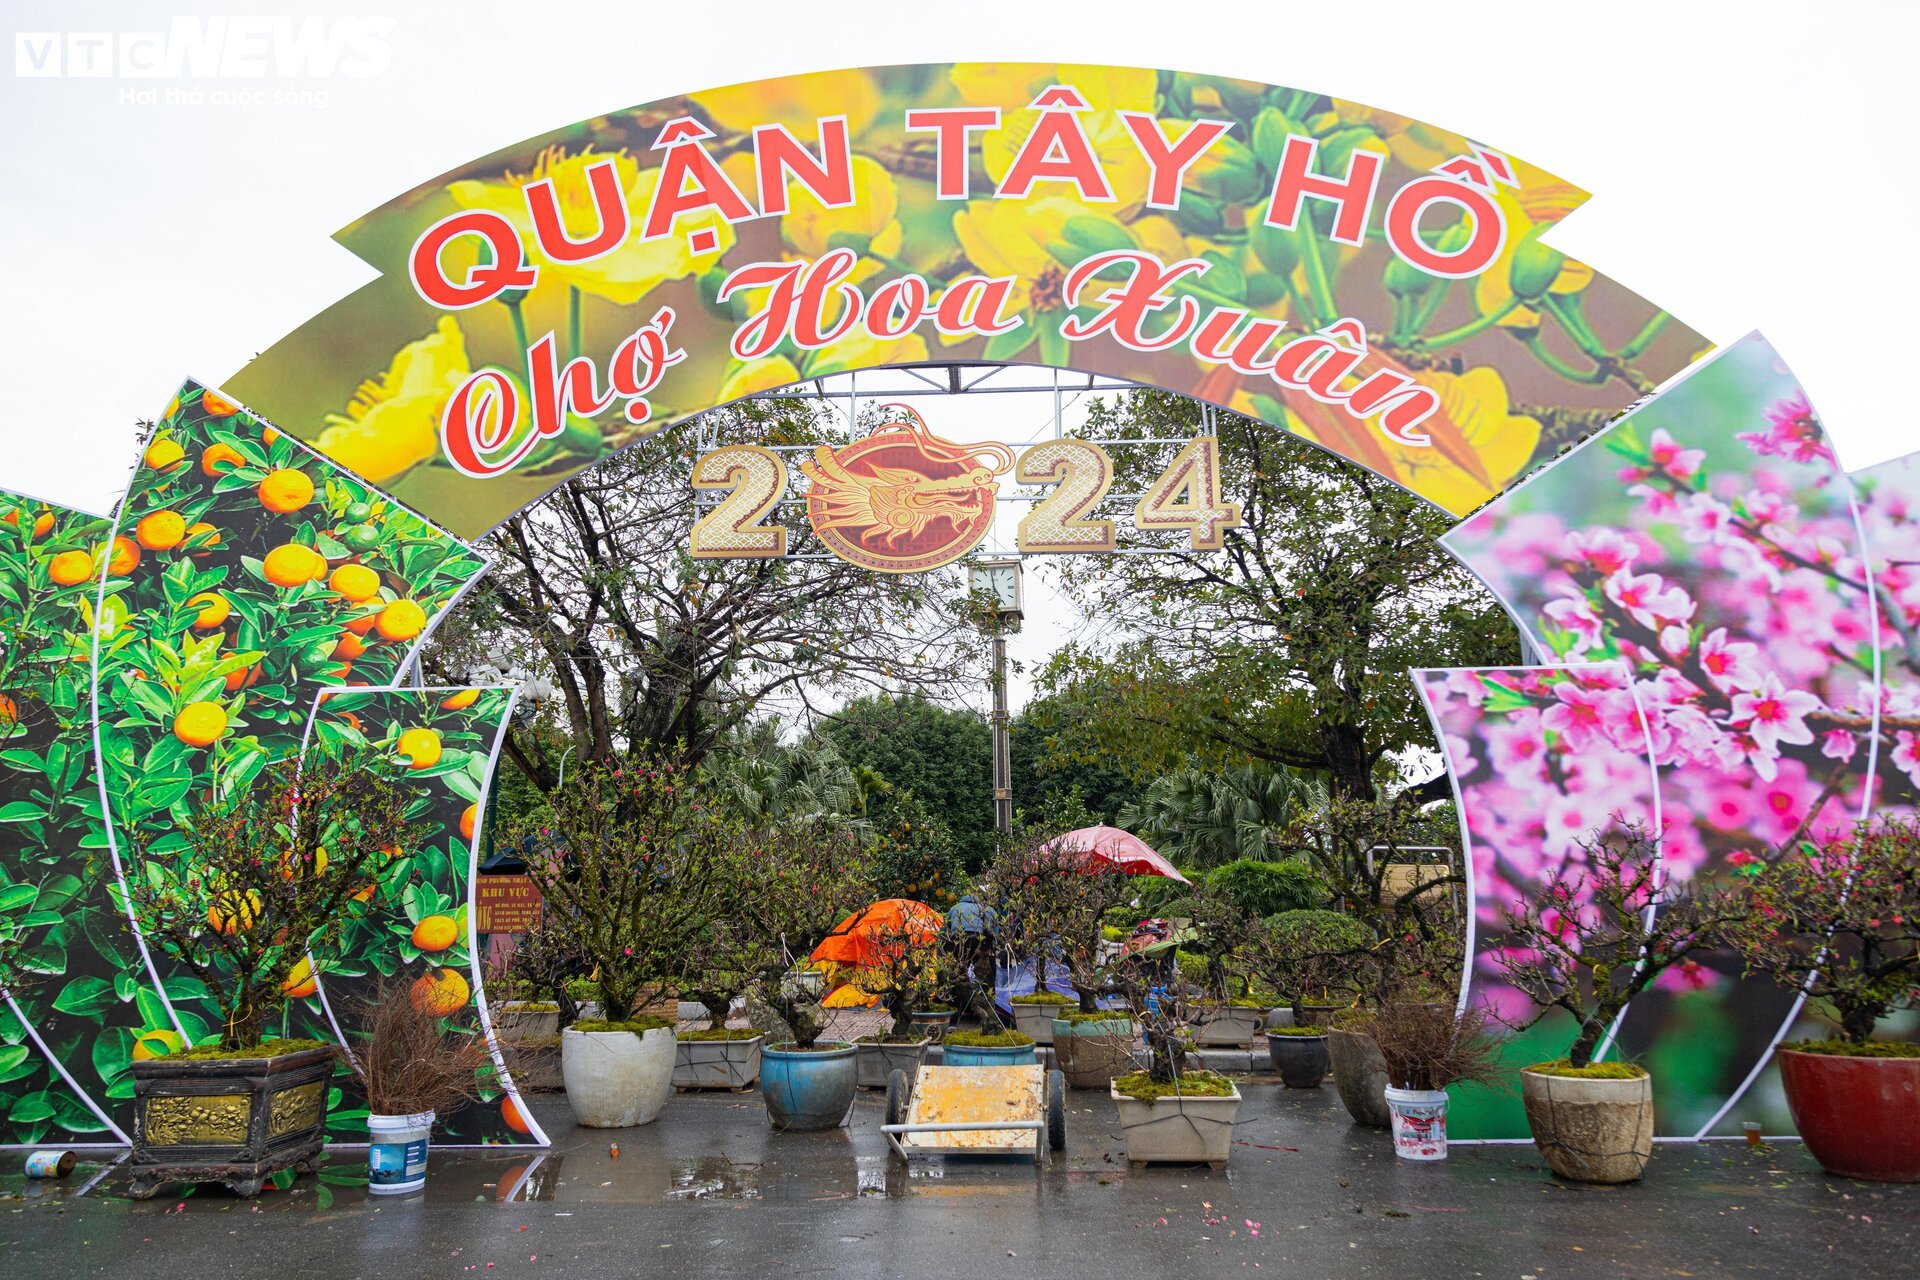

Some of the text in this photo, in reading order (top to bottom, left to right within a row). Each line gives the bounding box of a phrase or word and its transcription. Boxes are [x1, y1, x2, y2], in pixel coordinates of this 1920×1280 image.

[409, 85, 1521, 310] QUẬN TÂY HỒ
[441, 247, 1441, 479] Chợ Hoa Xuân
[482, 886, 530, 899] KHU VỰC
